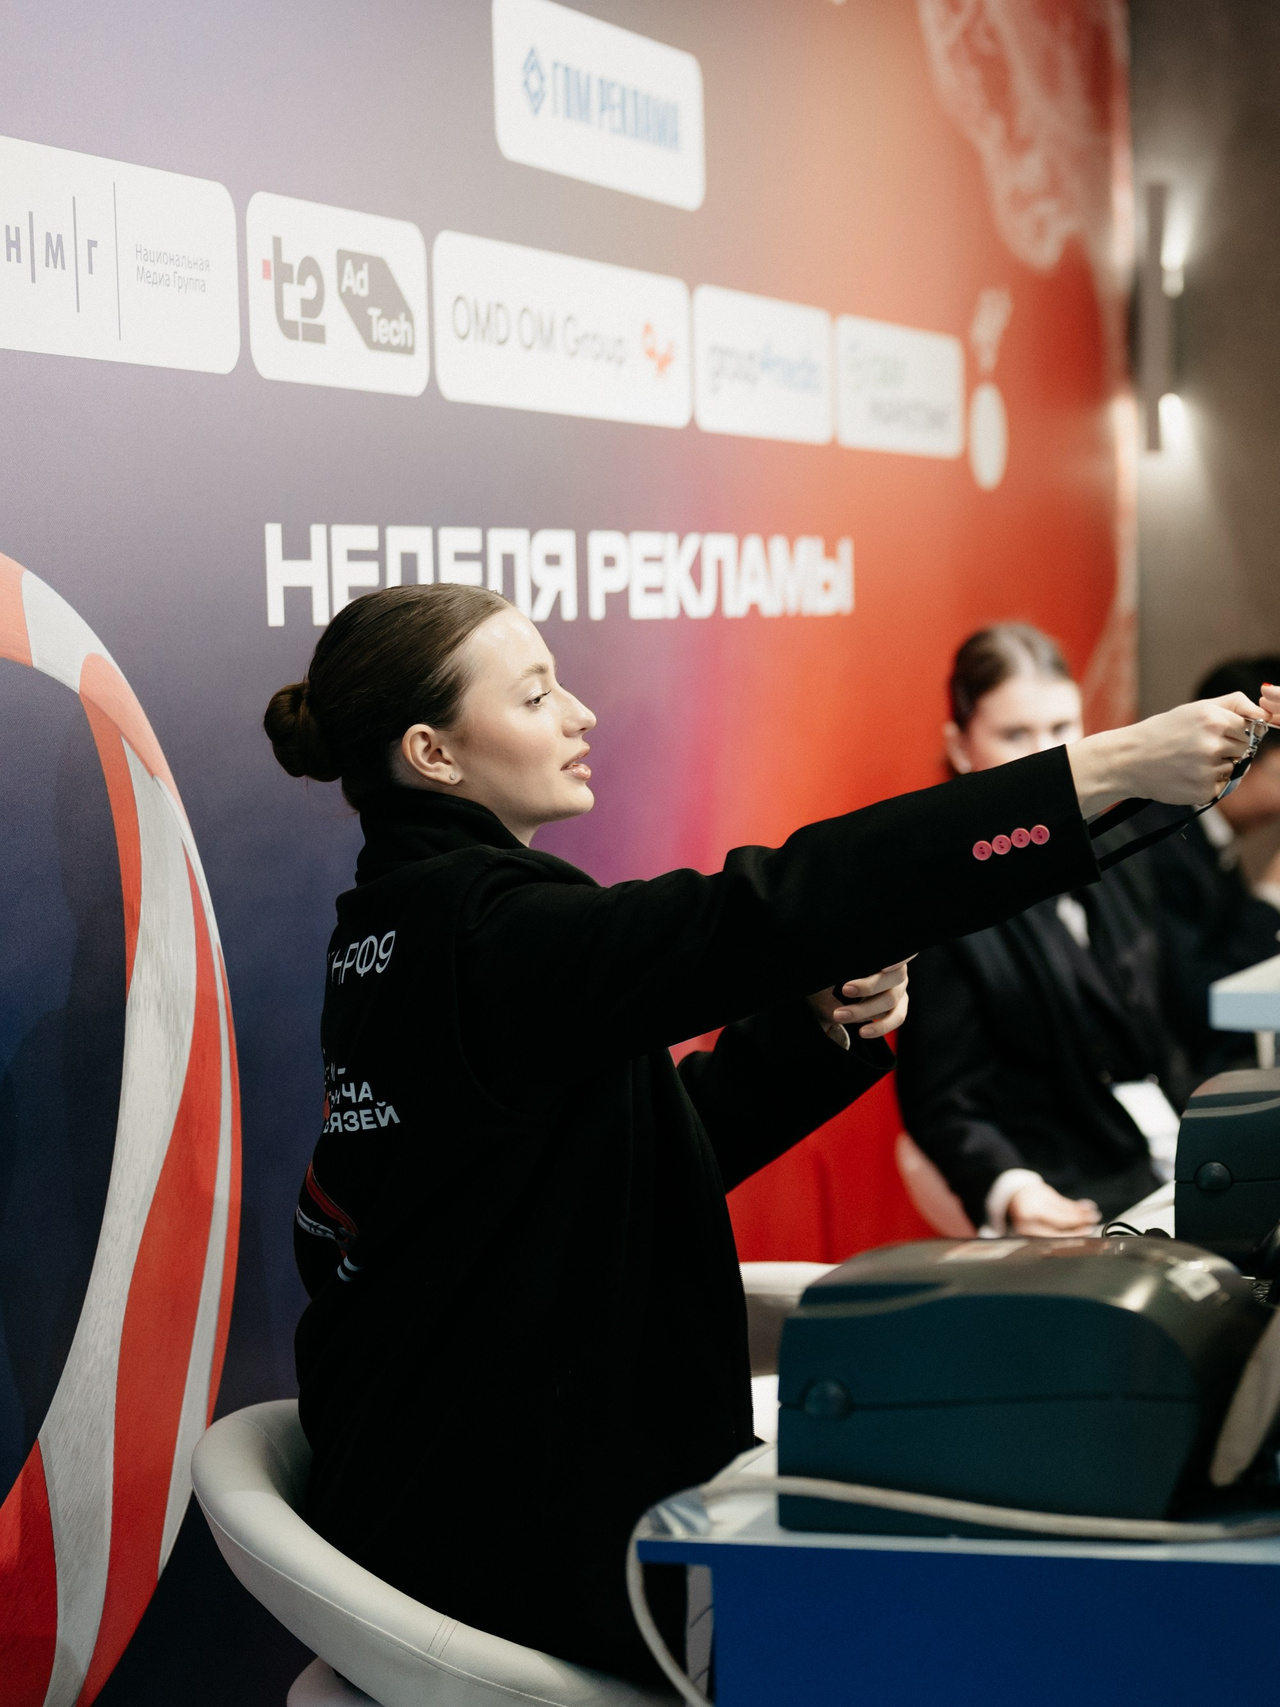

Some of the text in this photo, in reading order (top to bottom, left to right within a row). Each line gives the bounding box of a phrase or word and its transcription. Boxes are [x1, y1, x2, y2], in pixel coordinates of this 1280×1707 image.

[135, 244, 210, 271] Национальная
[136, 265, 206, 294] Медиа Группа
[341, 259, 369, 297] Ad
[367, 307, 413, 348] Tech
[451, 294, 627, 372] OMD OM Group
[587, 529, 855, 621] РЕКЛАМЫ
